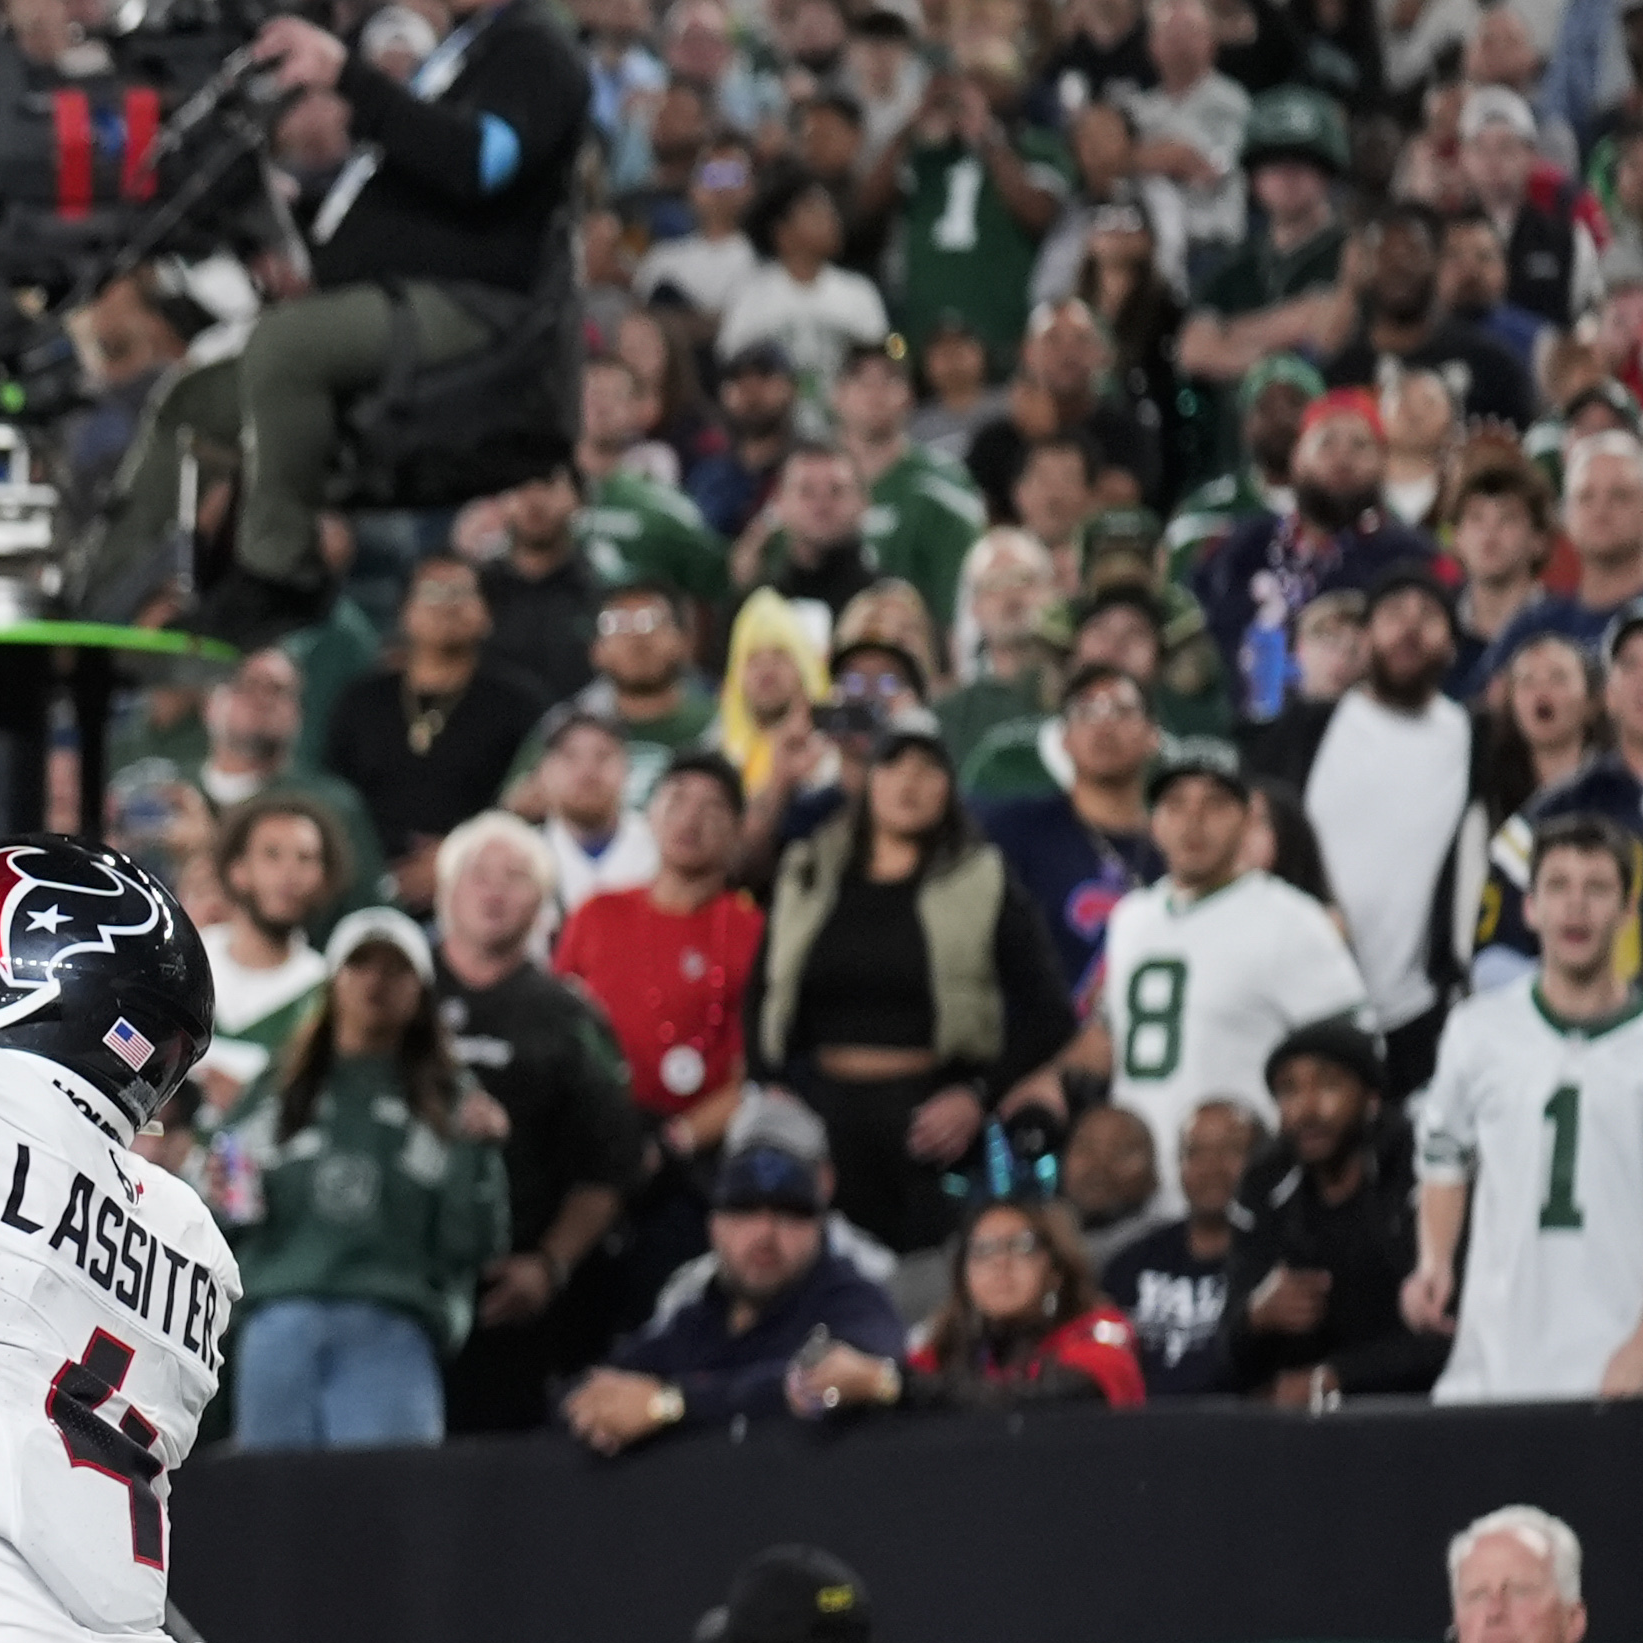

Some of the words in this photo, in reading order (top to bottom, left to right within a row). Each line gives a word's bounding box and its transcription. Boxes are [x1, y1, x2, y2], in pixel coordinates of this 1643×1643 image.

[1125, 959, 1188, 1078] 8
[1538, 1082, 1584, 1229] 1
[0, 1142, 218, 1372] LASSITER
[45, 1325, 166, 1572] 4
